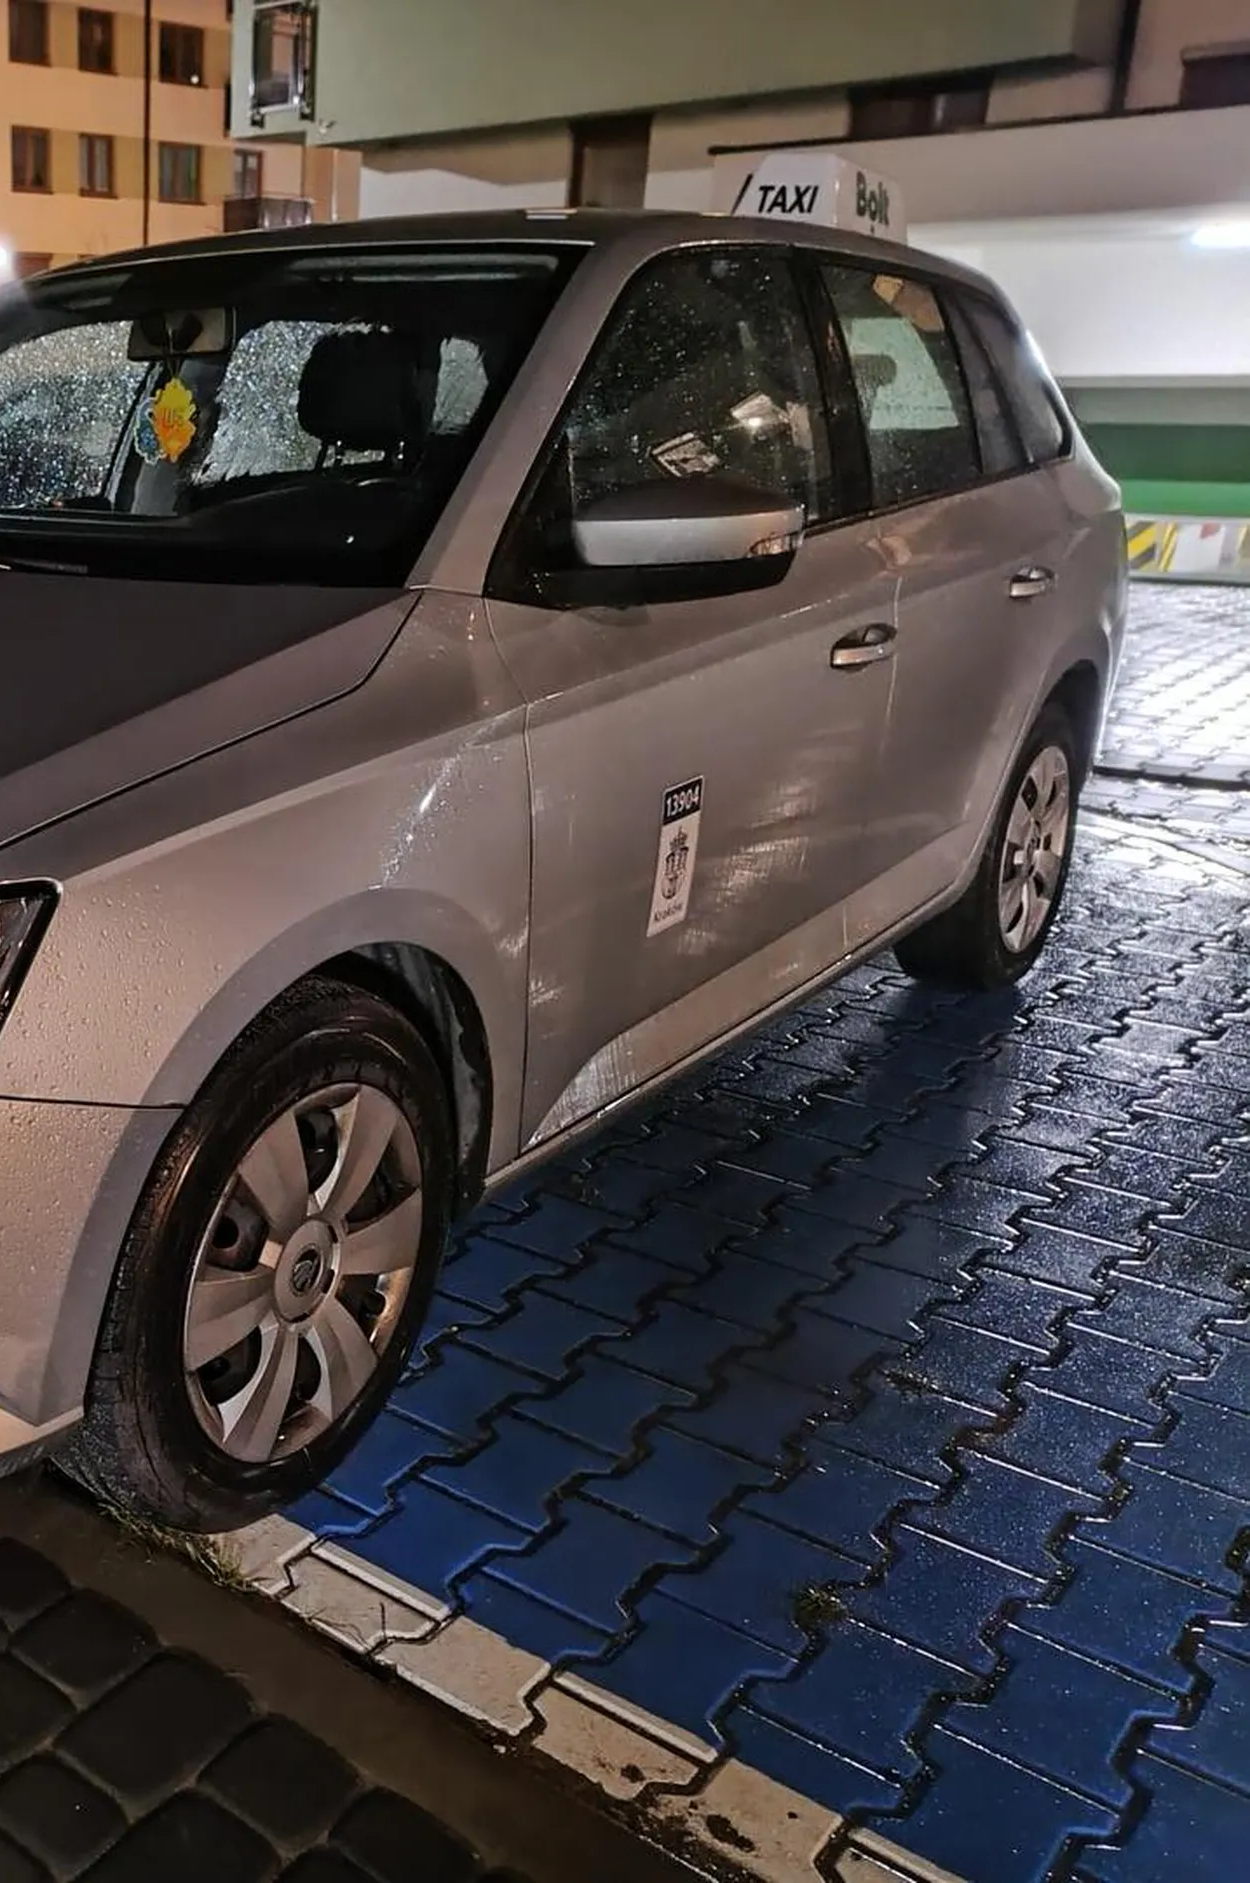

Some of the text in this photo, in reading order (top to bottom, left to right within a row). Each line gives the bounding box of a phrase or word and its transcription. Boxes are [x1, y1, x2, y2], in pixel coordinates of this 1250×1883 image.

[758, 185, 819, 214] TAXI
[855, 171, 890, 227] Bolt
[666, 784, 700, 817] 13904
